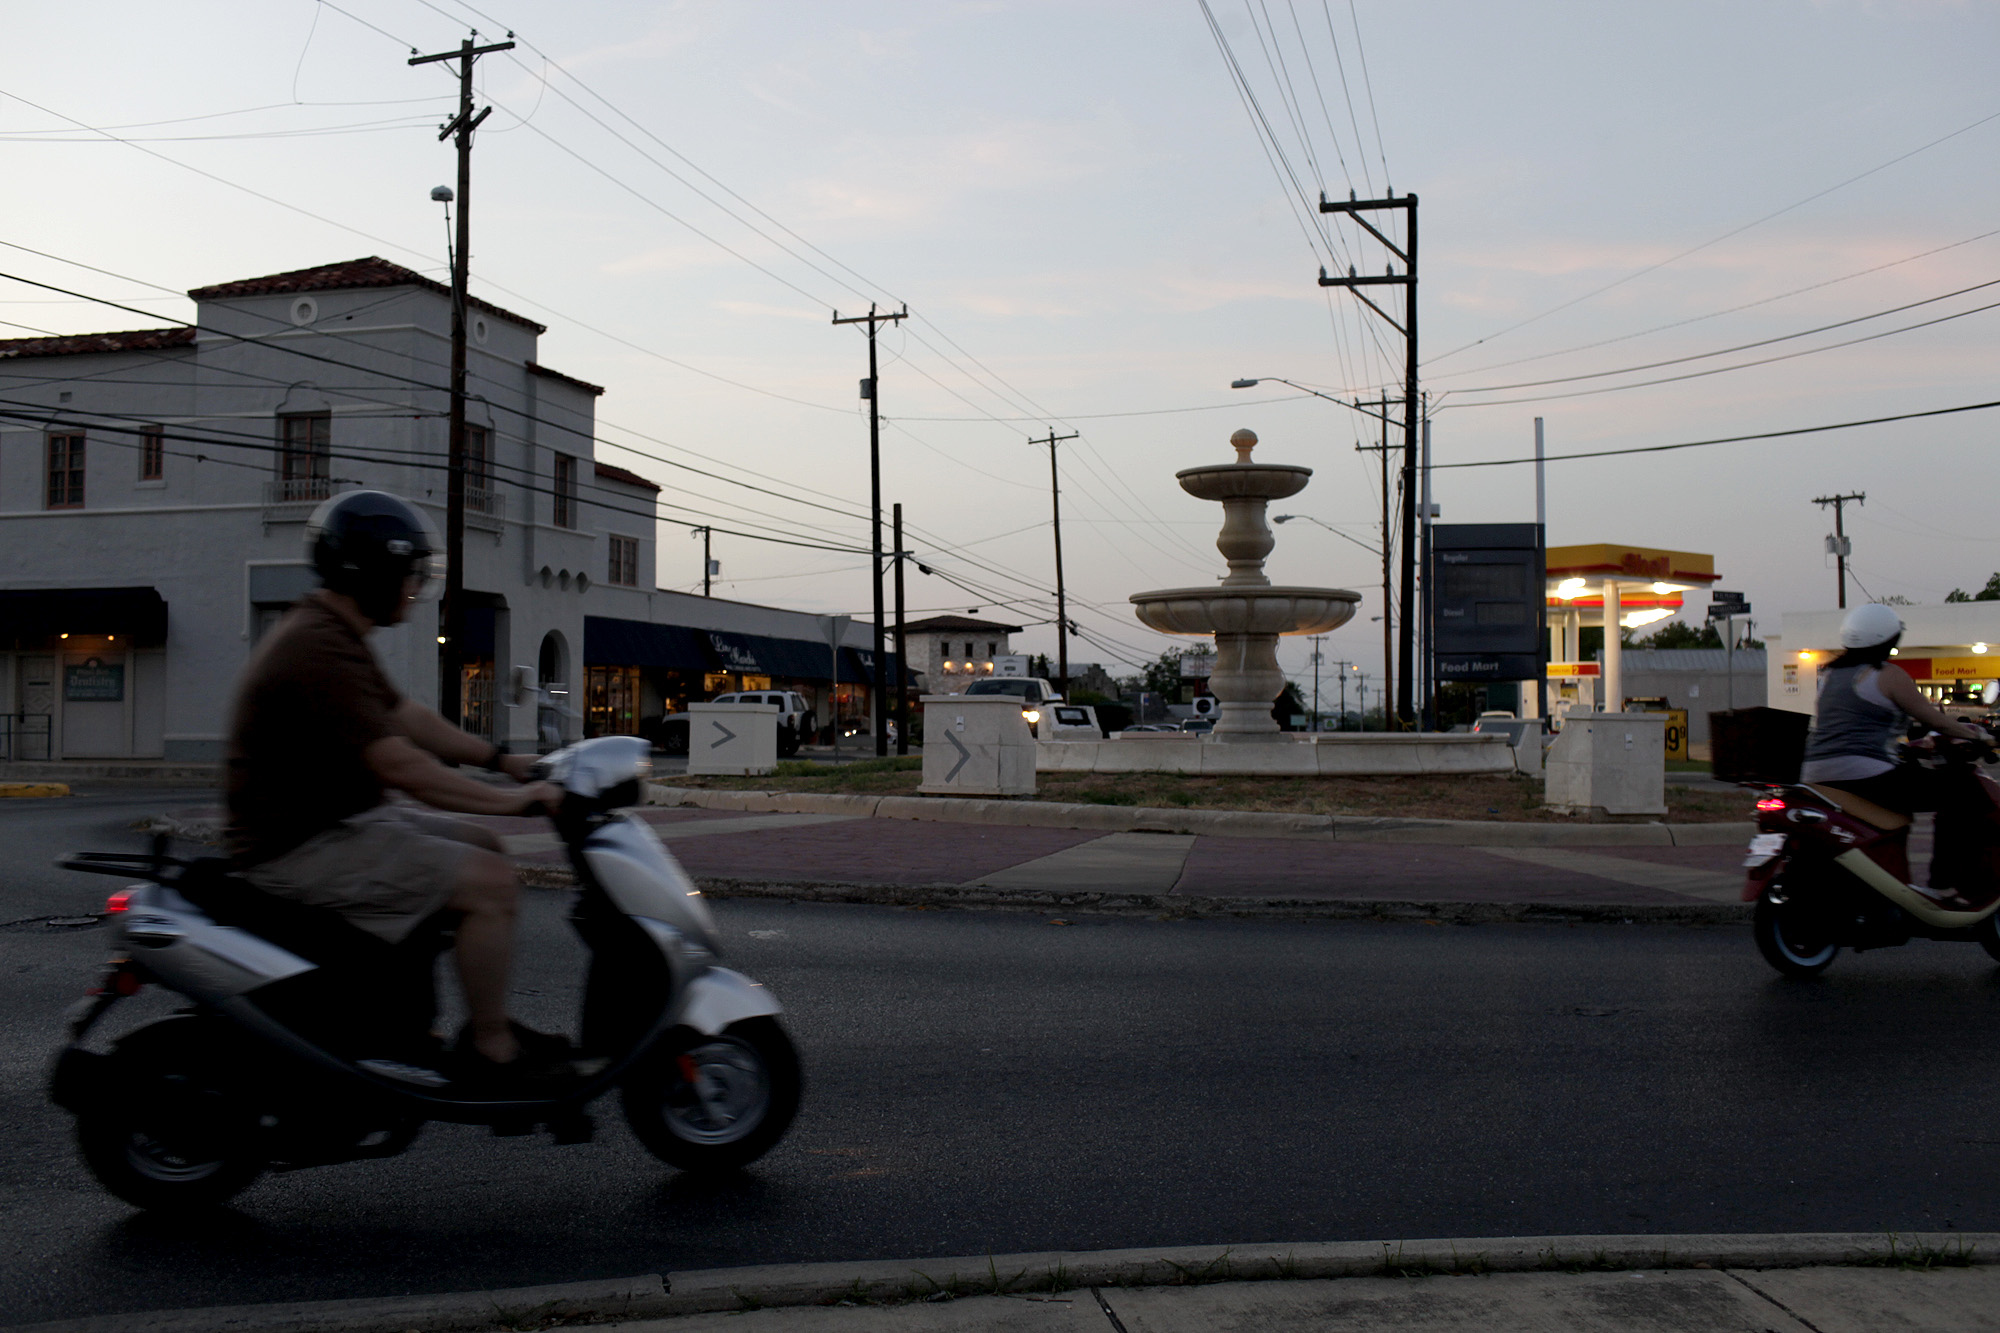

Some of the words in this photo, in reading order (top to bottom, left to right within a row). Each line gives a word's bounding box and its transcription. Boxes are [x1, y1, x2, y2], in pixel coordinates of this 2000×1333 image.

[1443, 553, 1468, 563] Regular
[1623, 553, 1670, 577] Shell
[1443, 608, 1465, 617] Diesel
[1441, 662, 1469, 673] Food
[1471, 661, 1499, 672] Mart
[1935, 667, 1955, 675] Food
[1957, 667, 1976, 675] Mart
[70, 675, 116, 689] Dentistry
